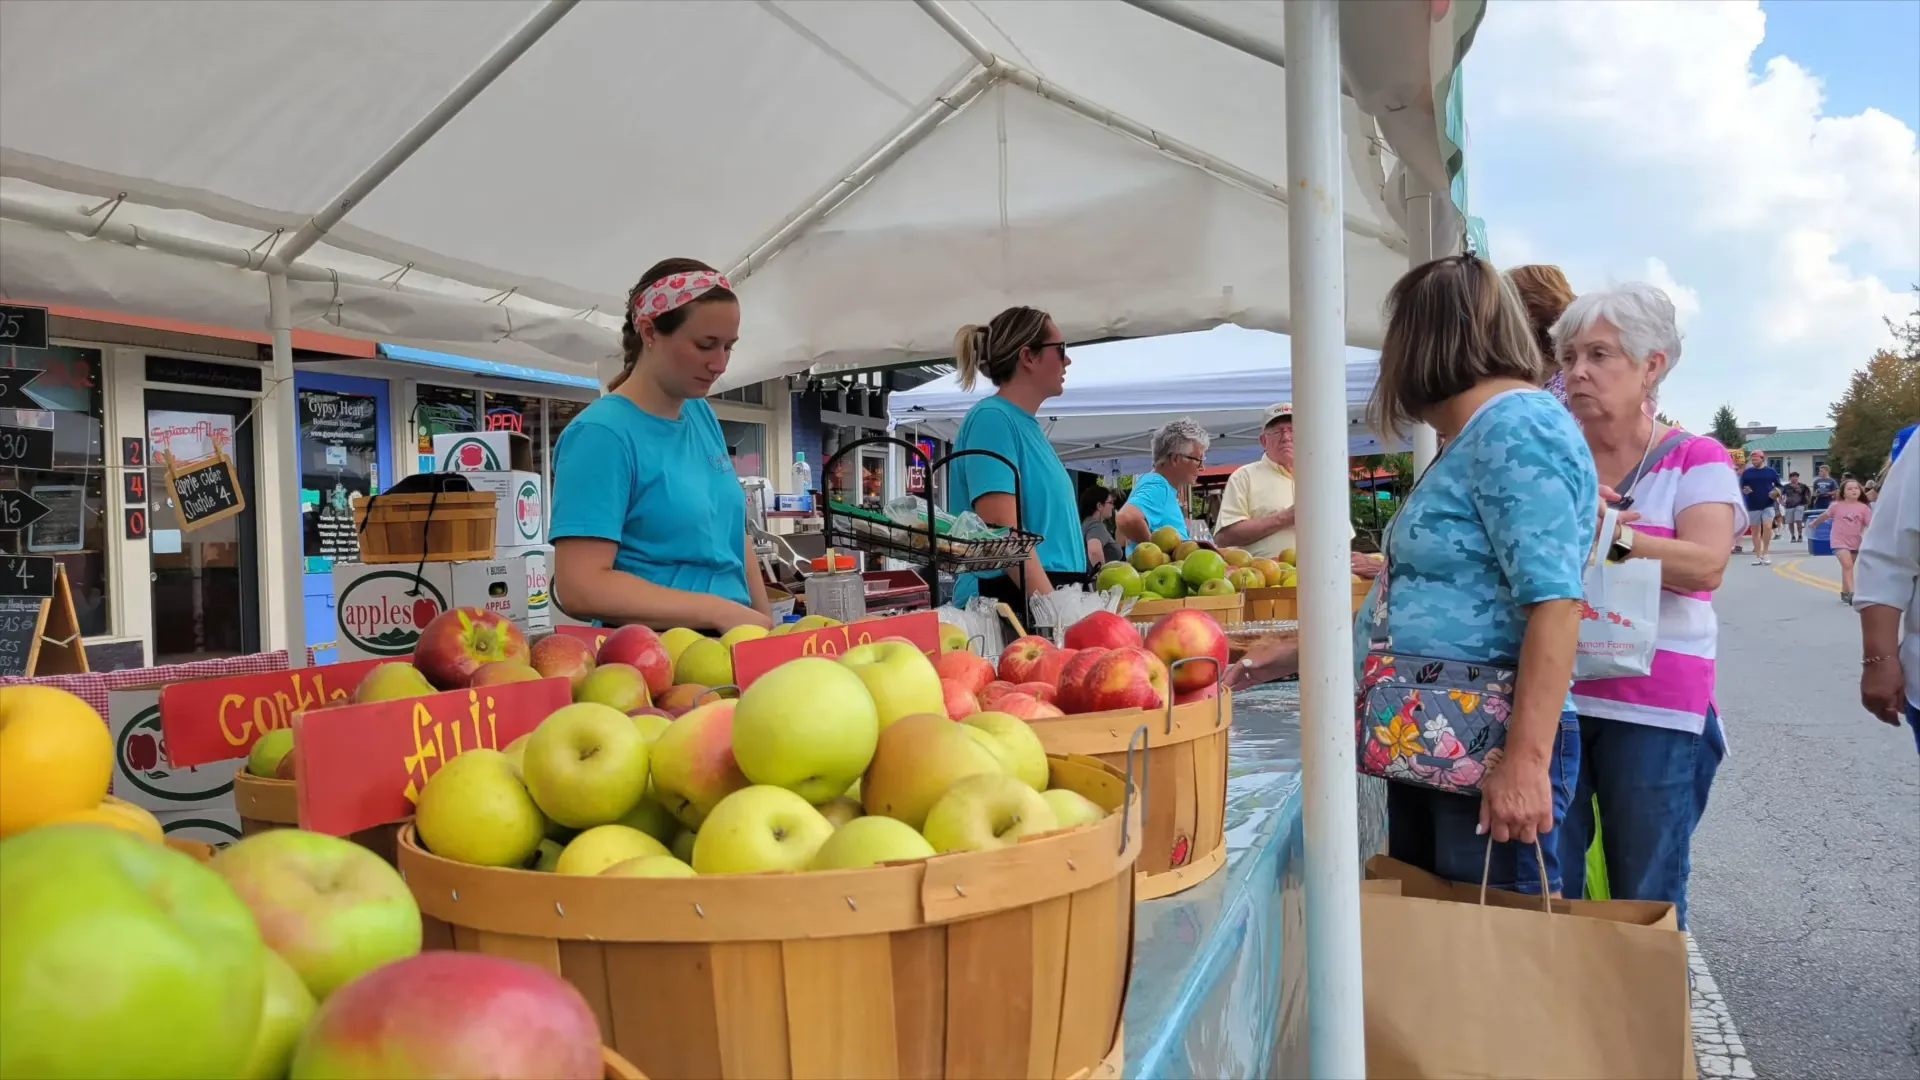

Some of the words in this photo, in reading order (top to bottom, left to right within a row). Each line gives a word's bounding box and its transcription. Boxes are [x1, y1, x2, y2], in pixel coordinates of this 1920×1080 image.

[308, 398, 338, 418] Gypsy
[340, 401, 364, 417] Heart
[484, 414, 522, 432] OPEN
[175, 475, 199, 496] apple
[200, 468, 222, 486] cider
[486, 600, 510, 610] APPLES
[346, 594, 411, 636] apples
[1607, 640, 1634, 649] Farms
